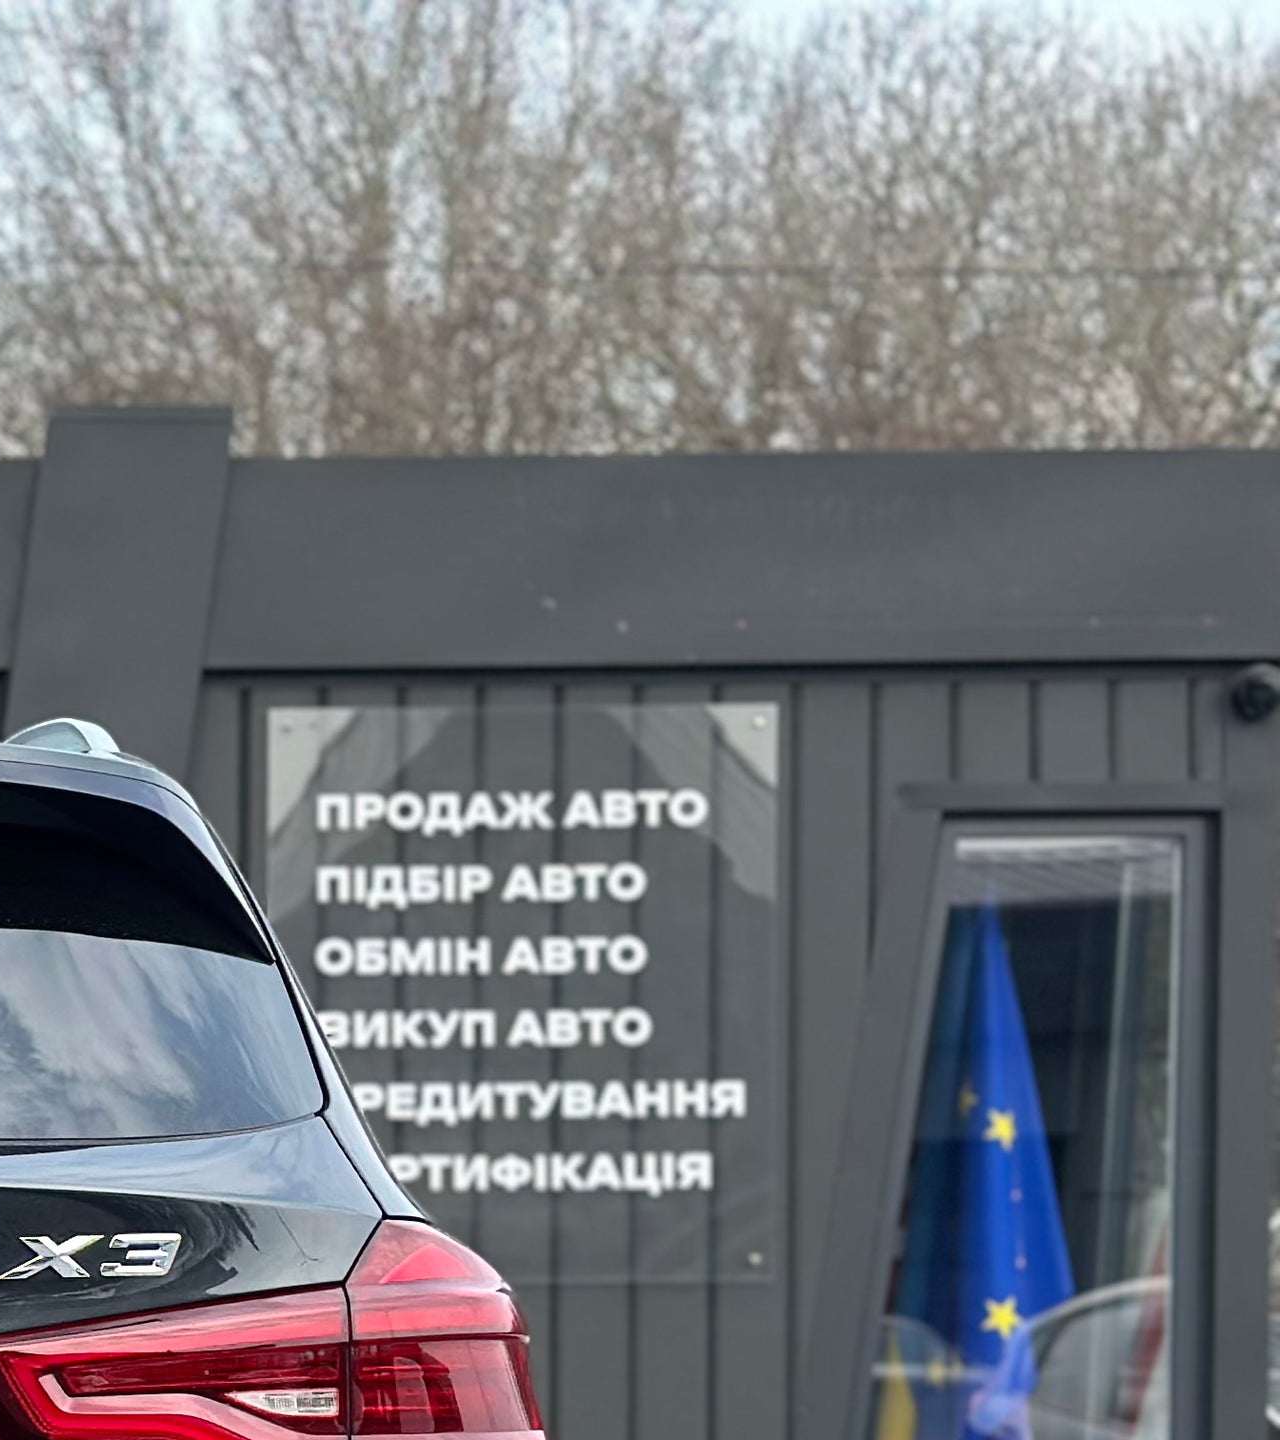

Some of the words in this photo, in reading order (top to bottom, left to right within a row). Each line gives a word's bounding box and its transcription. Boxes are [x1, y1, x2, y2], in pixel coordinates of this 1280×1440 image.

[316, 791, 554, 836] ПРОДАЖ
[562, 788, 708, 829] АВТО
[316, 864, 493, 909] ПІДБІР
[501, 861, 647, 902] АВТО
[314, 936, 491, 977] ОБМІН
[501, 934, 648, 975] АВТО
[507, 1006, 653, 1047] АВТО
[351, 1079, 747, 1126] РЕДИТУВАННЯ
[386, 1151, 714, 1198] РТИФІКАЦІЯ
